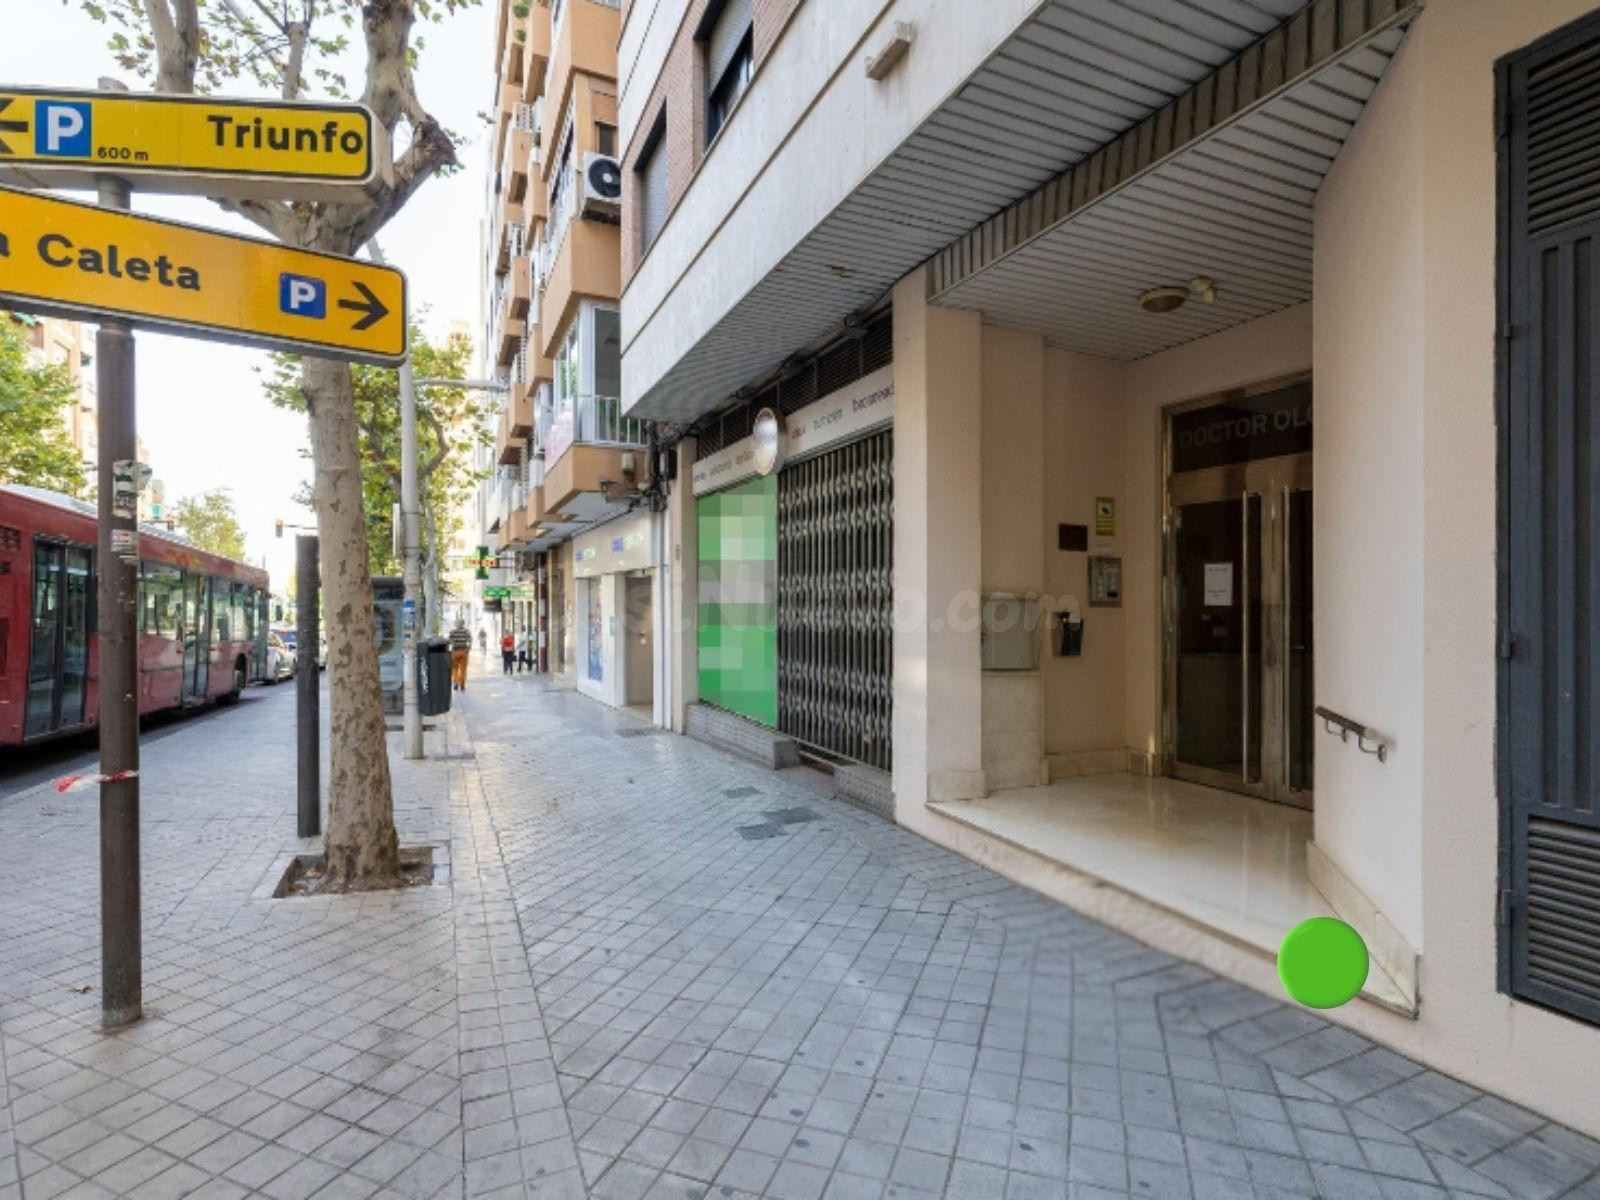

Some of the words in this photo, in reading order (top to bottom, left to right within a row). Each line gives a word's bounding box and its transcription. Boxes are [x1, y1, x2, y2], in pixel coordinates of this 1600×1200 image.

[47, 105, 84, 151] P
[207, 115, 364, 155] Triunfo
[98, 147, 131, 159] 600
[135, 151, 149, 161] m
[37, 233, 201, 291] Caleta
[289, 279, 316, 309] P
[1179, 413, 1268, 449] DOCTOR
